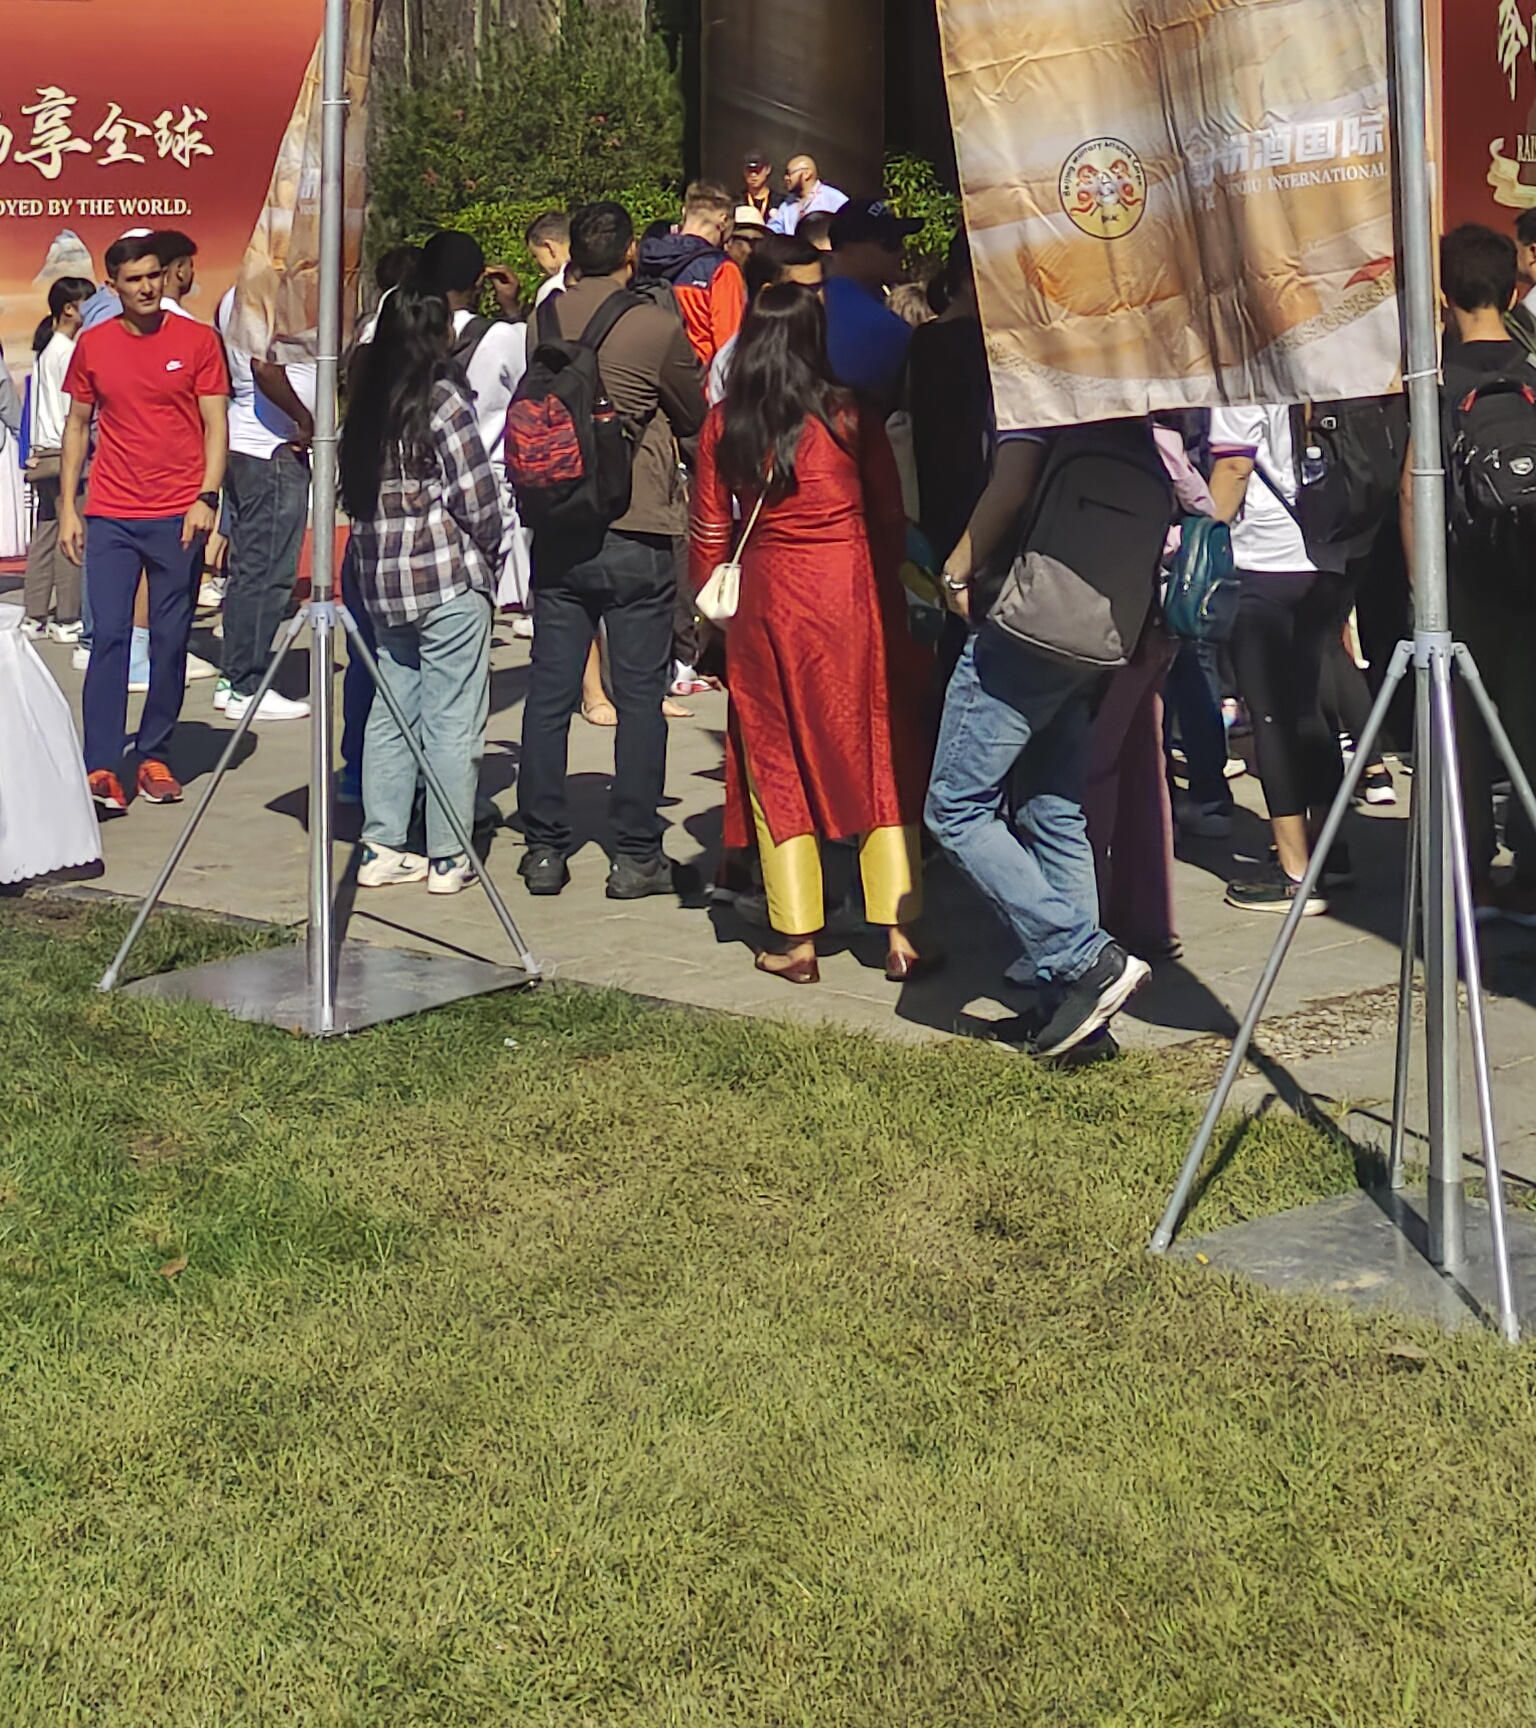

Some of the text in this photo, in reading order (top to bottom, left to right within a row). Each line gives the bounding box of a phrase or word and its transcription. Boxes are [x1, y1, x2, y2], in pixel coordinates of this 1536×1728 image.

[1267, 161, 1386, 191] INTERNATIONAL
[47, 198, 74, 216] BY
[77, 198, 116, 216] THE
[119, 198, 192, 216] WORLD.
